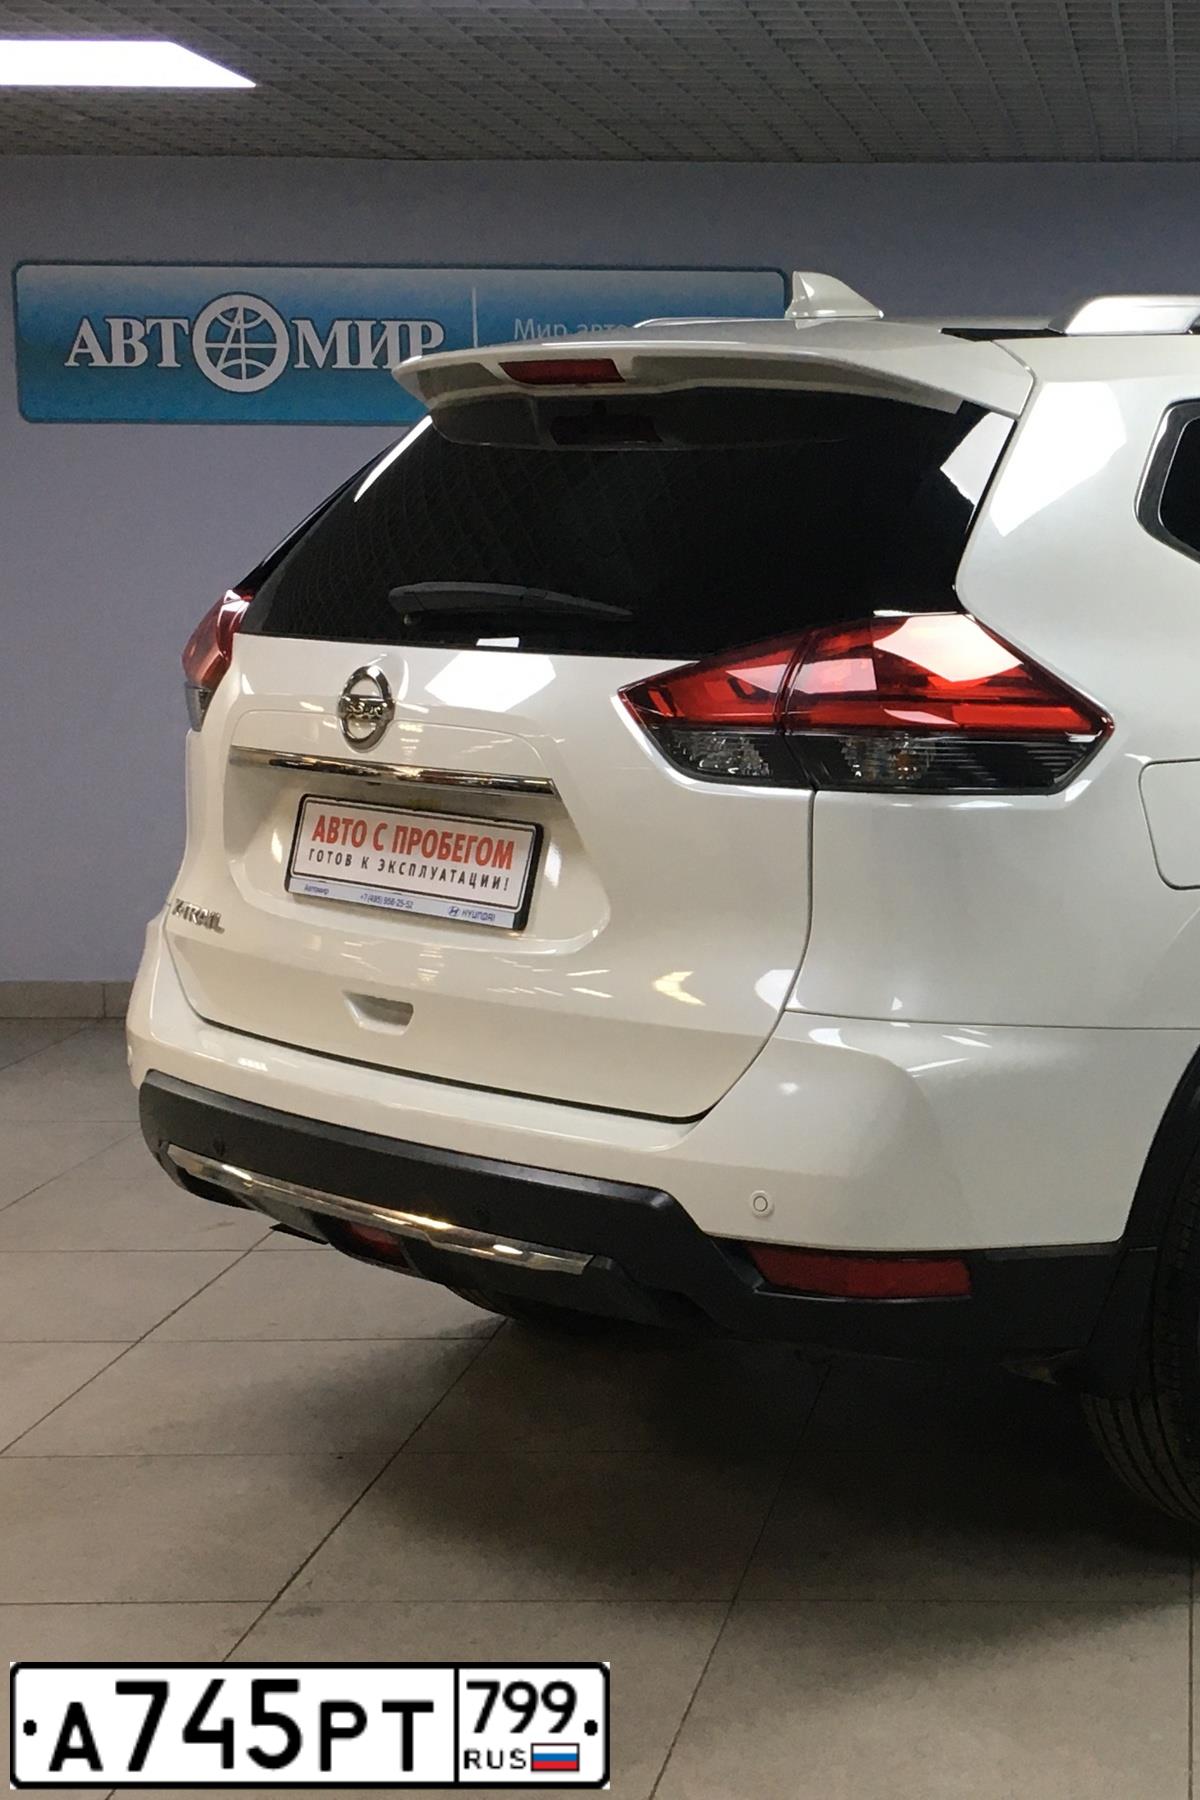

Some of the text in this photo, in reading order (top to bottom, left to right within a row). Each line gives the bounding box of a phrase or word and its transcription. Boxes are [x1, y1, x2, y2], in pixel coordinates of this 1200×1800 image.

[513, 318, 567, 340] Мир
[312, 814, 516, 870] АВТО С ПРОБЕГОМ
[308, 848, 510, 892] ГОТОВ К ЭКСПЛУАТАЦИИ!
[461, 908, 496, 922] HYUNDAI
